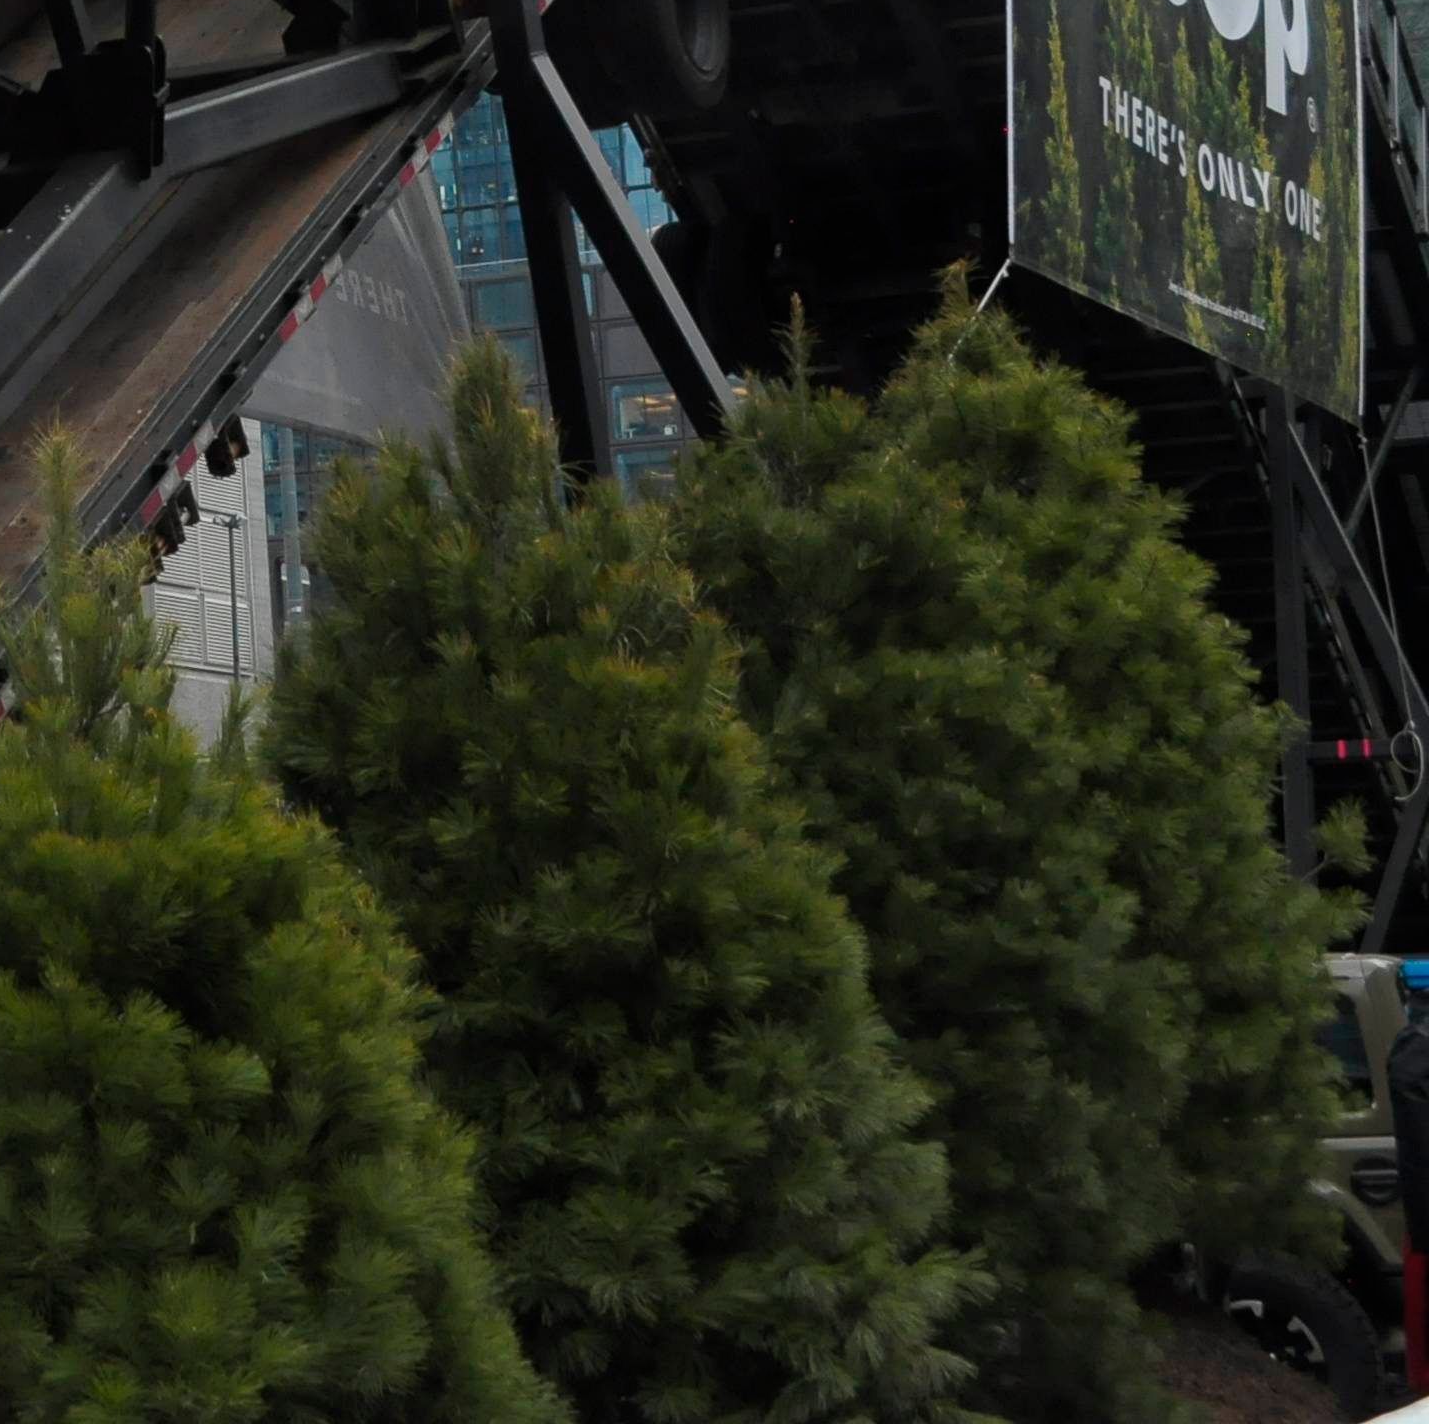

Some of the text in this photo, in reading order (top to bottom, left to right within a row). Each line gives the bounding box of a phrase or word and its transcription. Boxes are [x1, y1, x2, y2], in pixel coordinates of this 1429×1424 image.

[1098, 76, 1322, 242] THERE'S ONLY ONE
